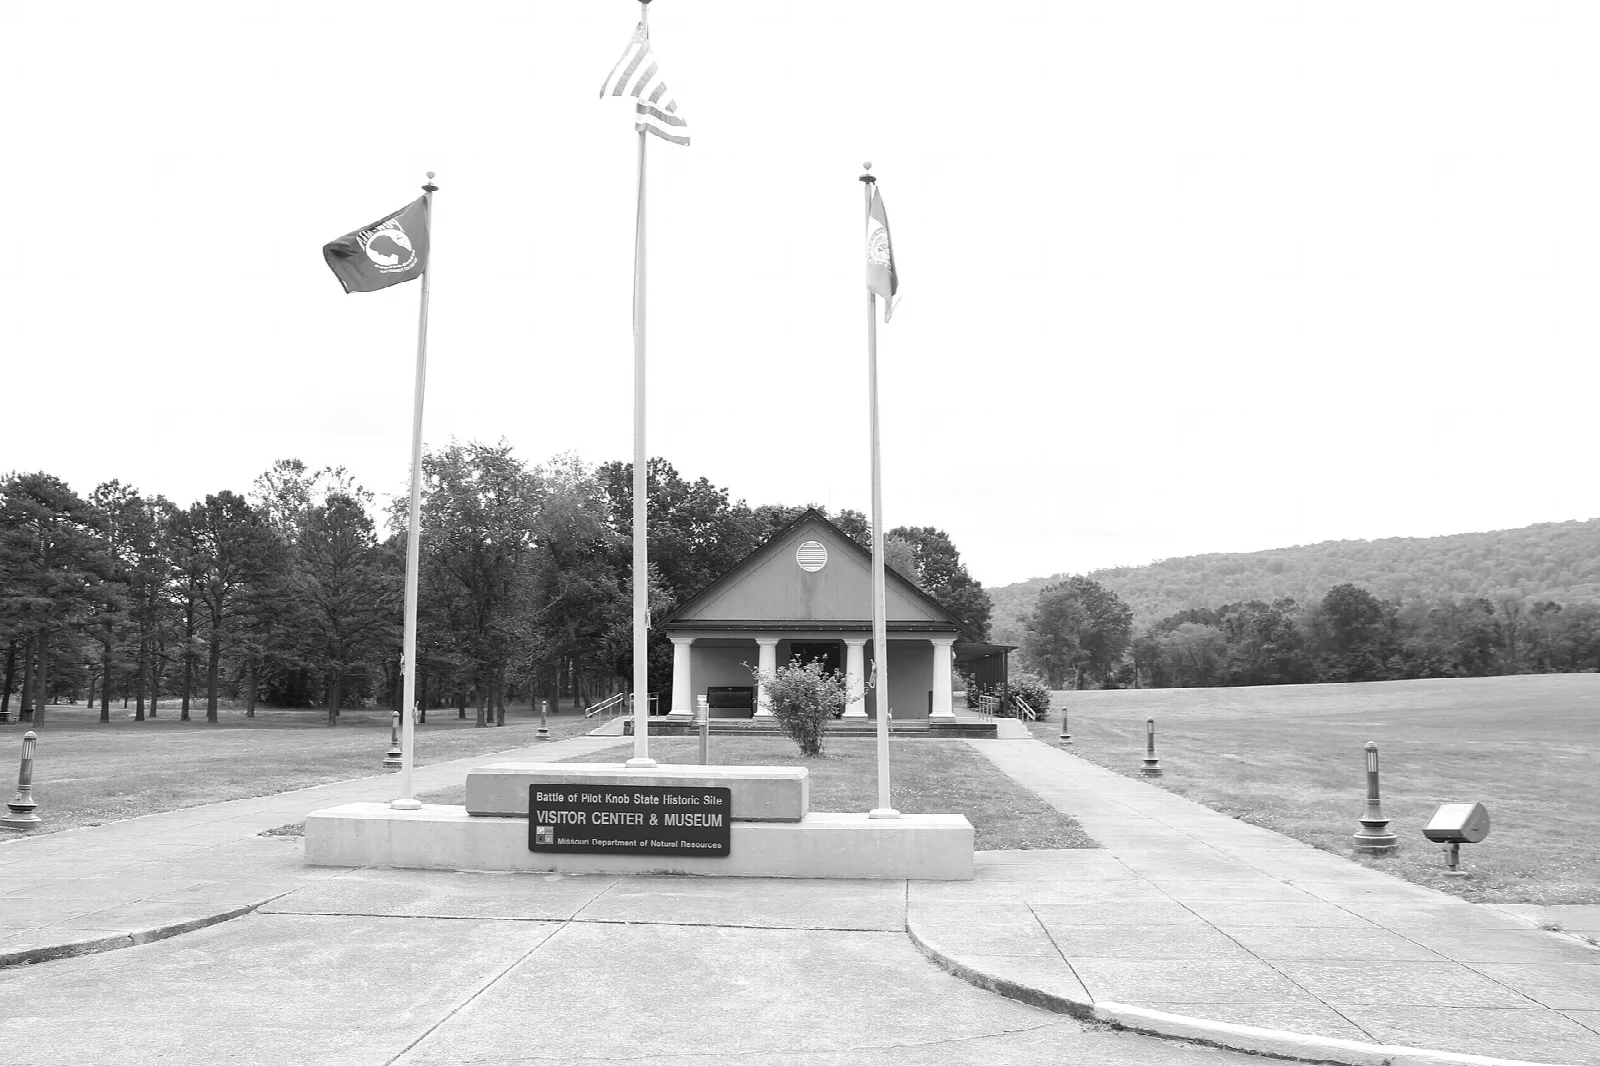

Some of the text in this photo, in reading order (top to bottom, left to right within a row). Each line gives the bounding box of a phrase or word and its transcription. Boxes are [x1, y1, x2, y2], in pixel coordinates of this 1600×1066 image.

[536, 791, 723, 805] Battle of Pilot Knob State Historic Site
[536, 810, 723, 827] VISITOR CENTER & MUSEUM
[557, 837, 722, 849] Missouri Department of Natural Resources
